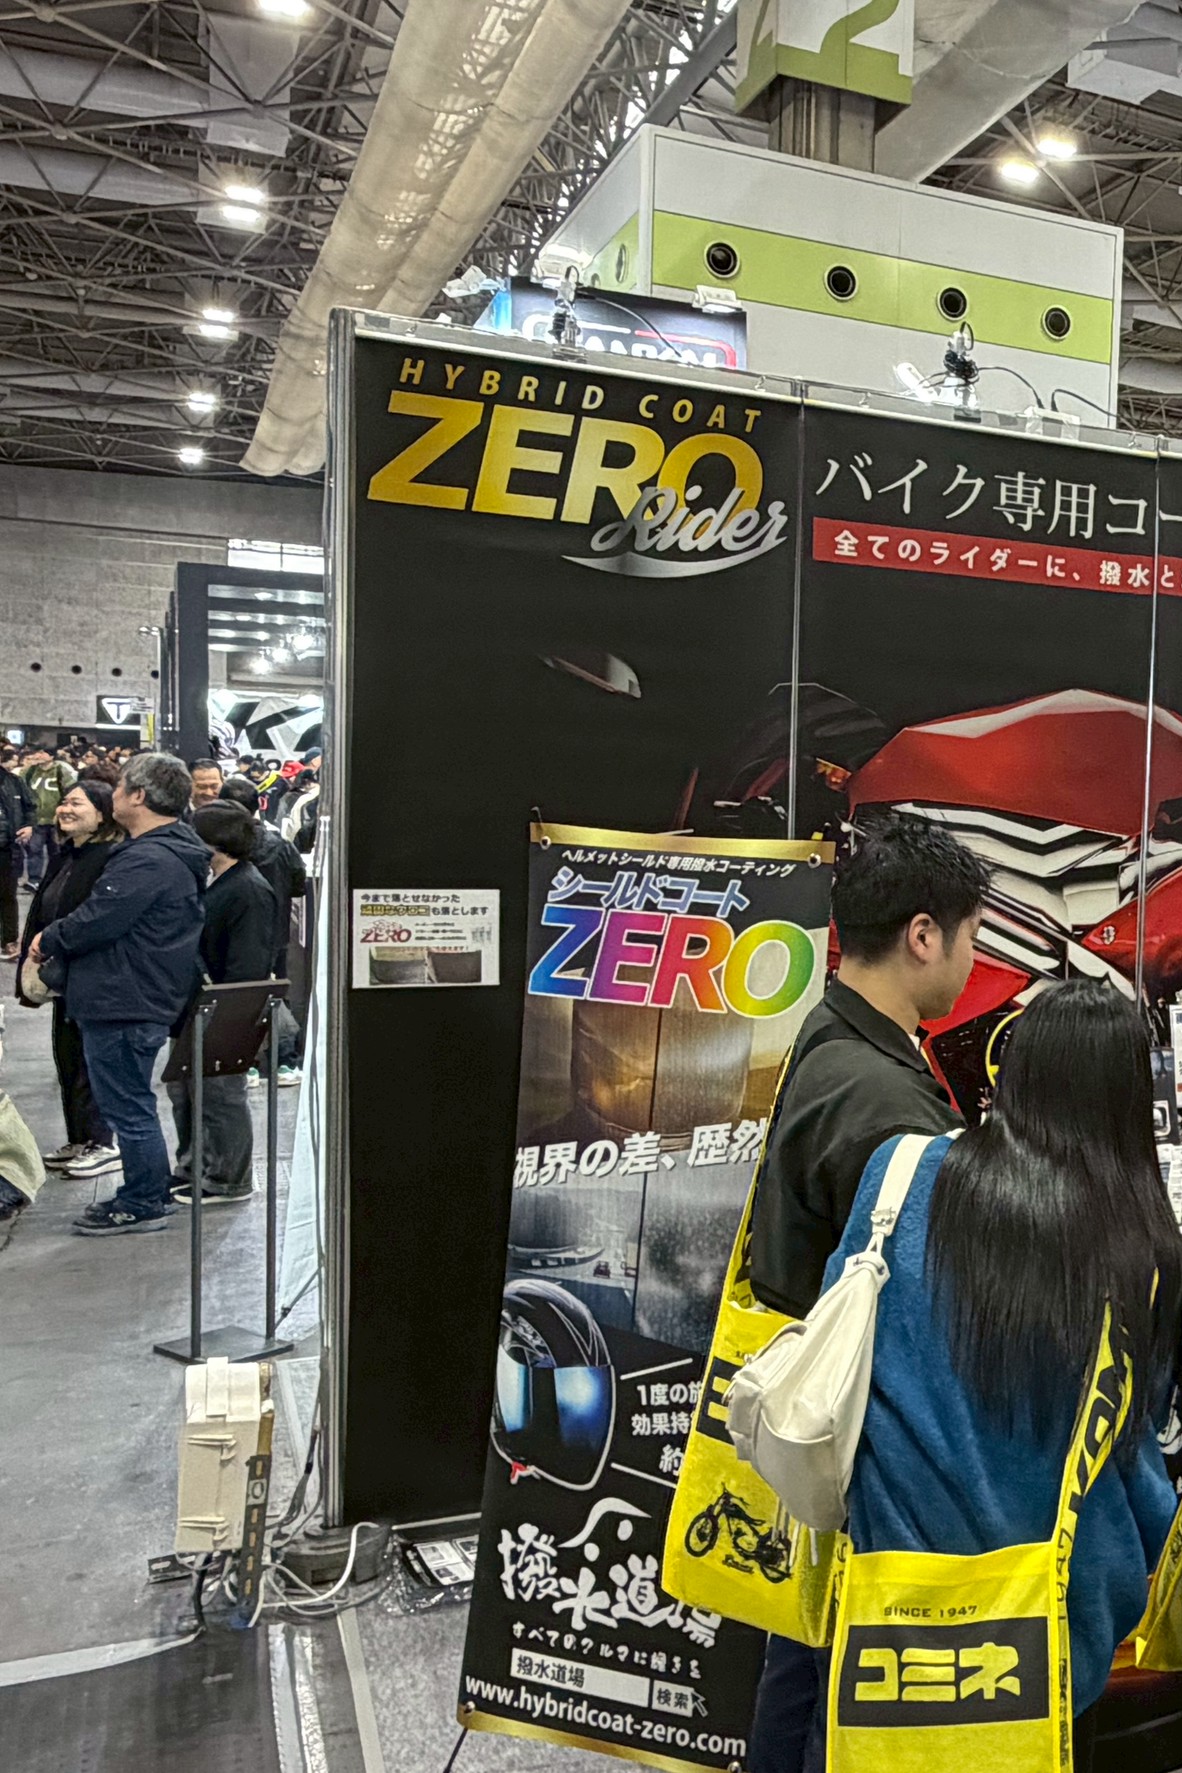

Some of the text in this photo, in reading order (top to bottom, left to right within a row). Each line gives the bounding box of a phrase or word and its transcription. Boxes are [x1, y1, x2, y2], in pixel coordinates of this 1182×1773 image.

[400, 358, 763, 433] HYBRID COAT
[367, 390, 764, 538] ZERO
[590, 486, 789, 553] Rider
[547, 865, 750, 918] シールドコート
[528, 903, 815, 1019] ZERO
[631, 1410, 696, 1436] 効果持
[884, 1605, 978, 1618] SINCE 1947
[516, 1653, 586, 1688] 撥水道場
[656, 1686, 690, 1710] 検索
[855, 1642, 1021, 1702] コミネ
[465, 1674, 747, 1757] www.hybridcoat-zero.com
